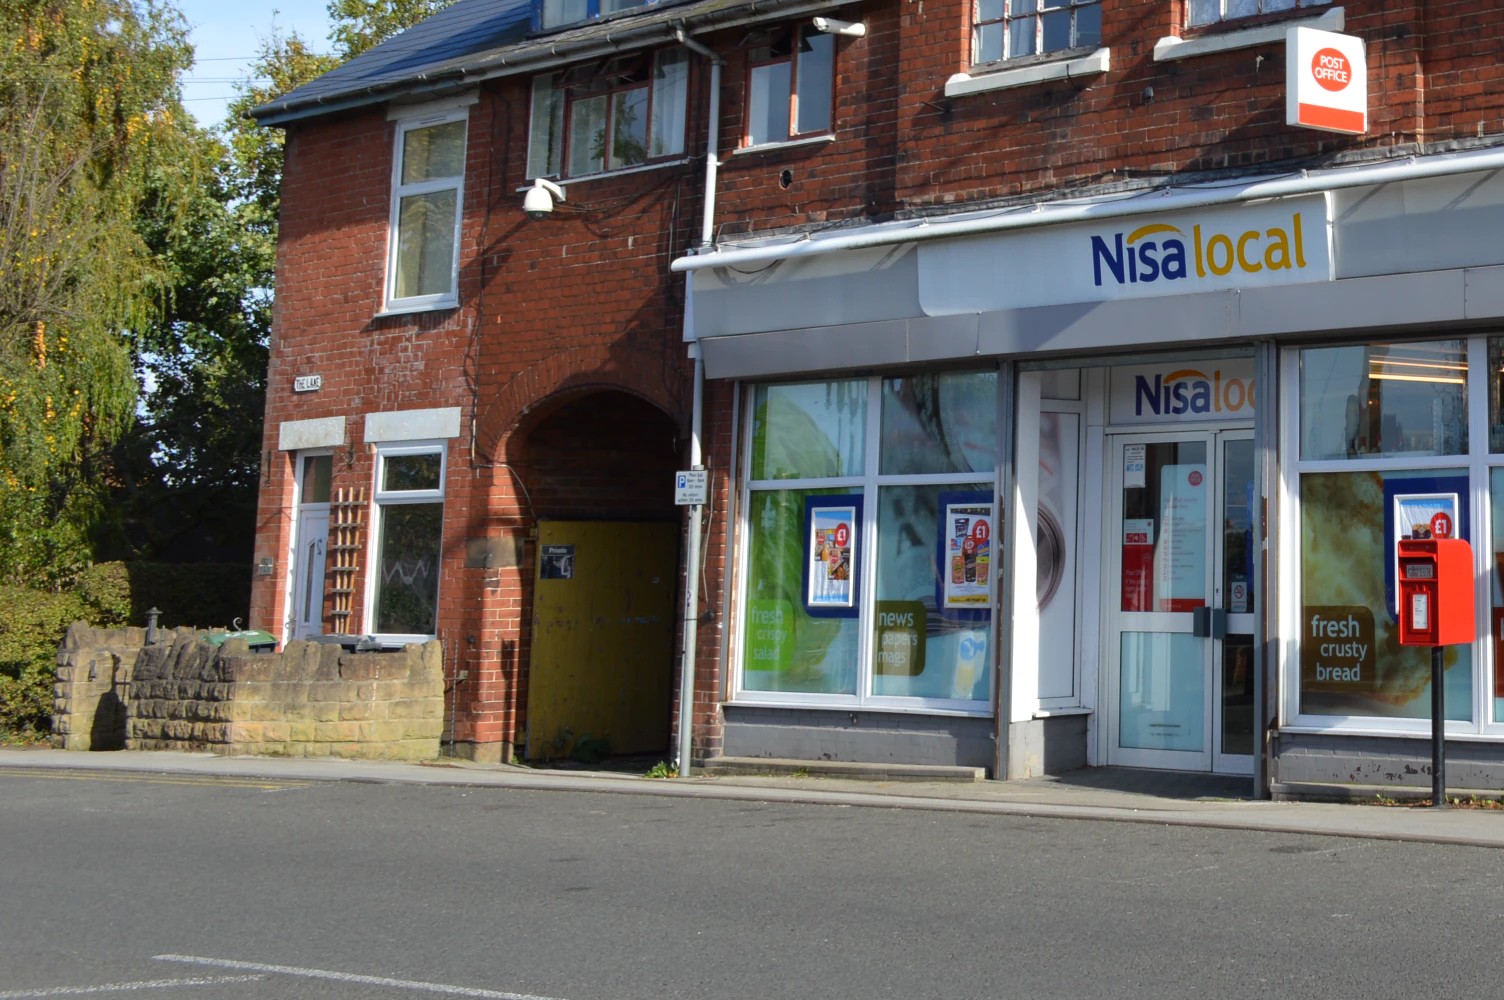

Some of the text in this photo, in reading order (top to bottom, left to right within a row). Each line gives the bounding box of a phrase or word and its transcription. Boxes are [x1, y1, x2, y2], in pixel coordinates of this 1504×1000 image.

[1320, 55, 1344, 70] POST
[1314, 67, 1348, 83] OFFICE
[1090, 213, 1307, 286] Nisa local
[1135, 370, 1210, 416] Nisa
[976, 526, 986, 539] £1
[1435, 519, 1447, 534] £1
[837, 529, 846, 541] £1
[751, 607, 784, 624] fresh
[879, 612, 914, 627] news
[1311, 614, 1360, 637] fresh
[757, 628, 788, 643] crispy
[882, 631, 918, 646] papers
[753, 647, 780, 660] salad
[878, 650, 906, 667] mags
[1320, 641, 1367, 661] crusty
[1316, 662, 1360, 681] bread
